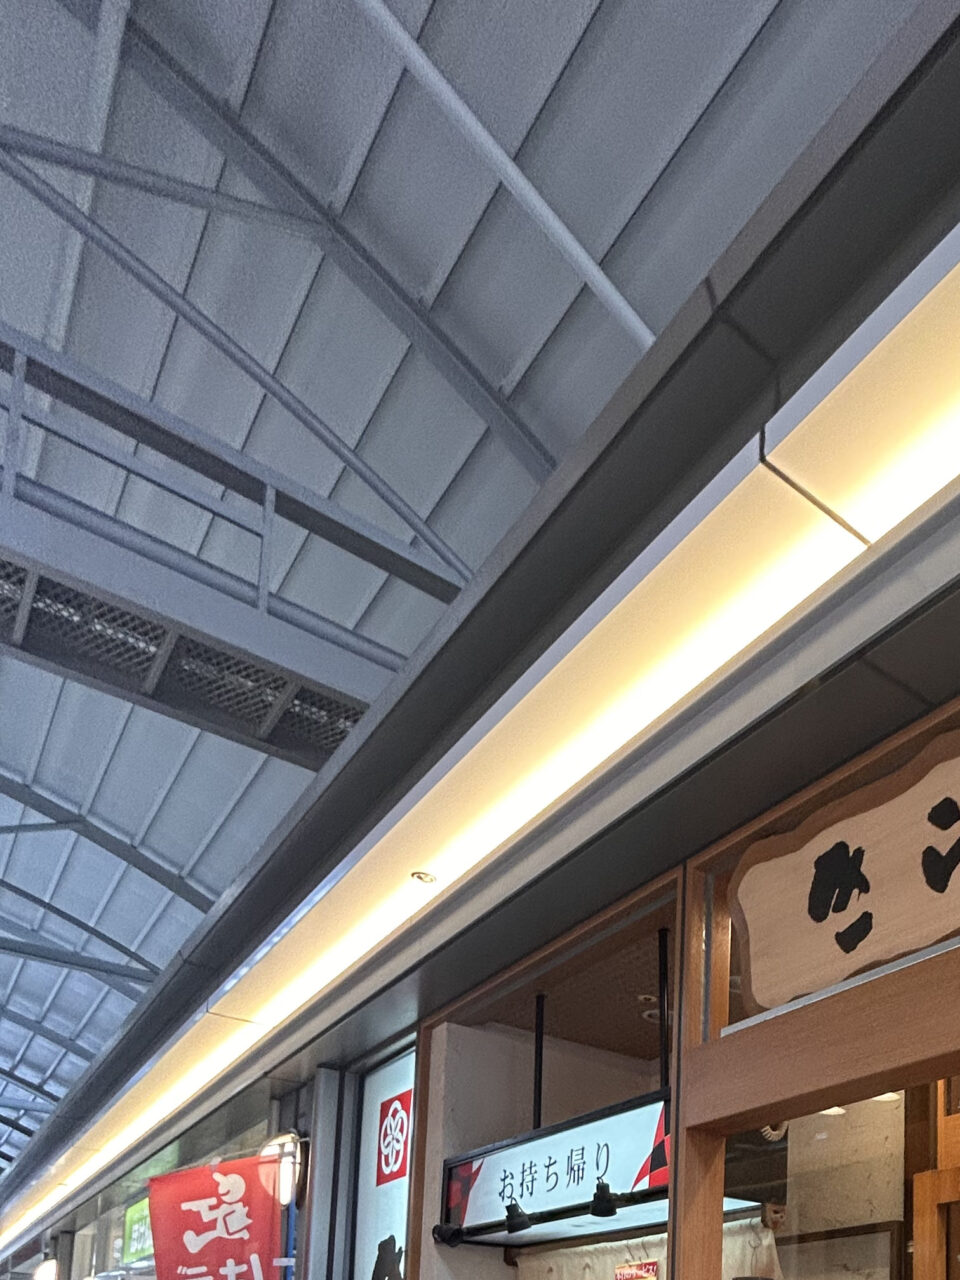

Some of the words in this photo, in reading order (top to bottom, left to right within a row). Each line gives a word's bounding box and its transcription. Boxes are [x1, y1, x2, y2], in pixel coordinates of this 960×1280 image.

[499, 1141, 611, 1202] お持ち帰り
